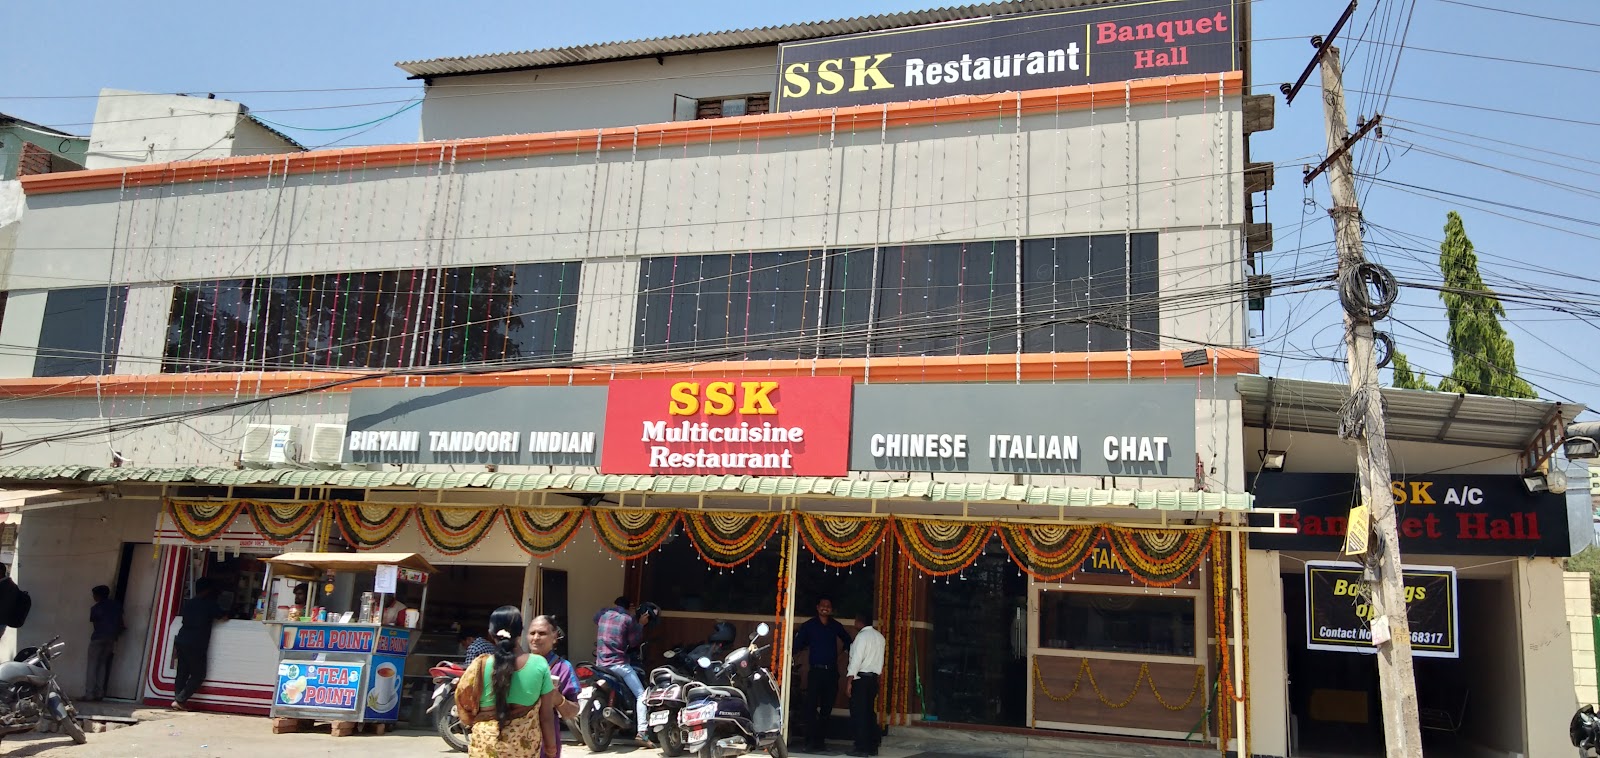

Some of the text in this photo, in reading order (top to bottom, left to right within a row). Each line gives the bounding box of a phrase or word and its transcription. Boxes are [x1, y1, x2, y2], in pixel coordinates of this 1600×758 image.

[1096, 11, 1228, 45] Banquet
[1134, 46, 1188, 70] Hall
[783, 42, 1080, 98] SSK Restaurant
[669, 381, 779, 416] SSK
[349, 431, 595, 453] BIRYANI TANDOORI INDIAN
[641, 421, 804, 443] Multicuisine
[649, 446, 792, 469] Restaurant
[870, 433, 1168, 462] CHINESE ITALIAN CHAT
[1391, 481, 1483, 506] SK A/C
[1279, 510, 1441, 539] Banet
[1456, 512, 1541, 540] Hall
[1092, 547, 1128, 570] TAK
[299, 629, 372, 650] TEA POINT
[390, 637, 408, 652] POINT
[1320, 626, 1356, 639] Contact
[1409, 631, 1443, 644] 68317
[317, 667, 349, 685] TEA
[303, 685, 356, 705] POINT
